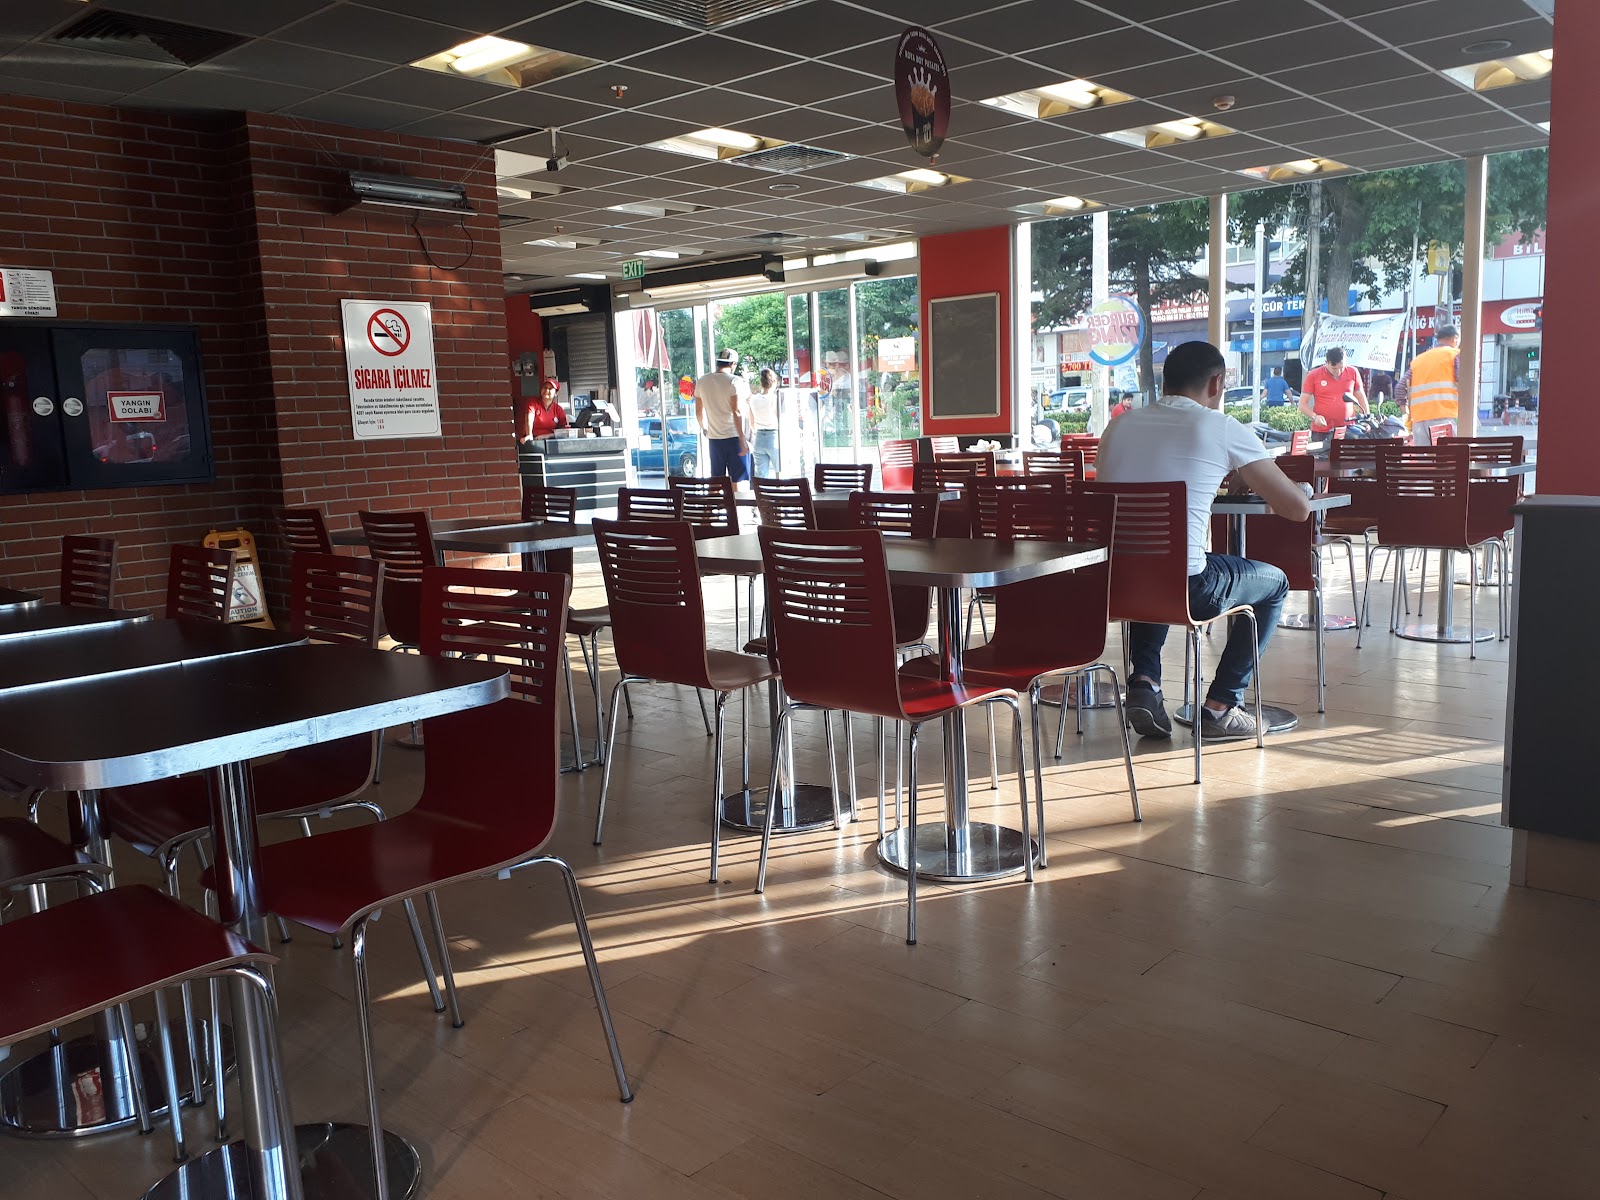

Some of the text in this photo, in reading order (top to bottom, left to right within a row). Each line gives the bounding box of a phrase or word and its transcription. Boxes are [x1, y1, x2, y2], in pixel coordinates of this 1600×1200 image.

[622, 260, 643, 279] EXIT
[1249, 300, 1284, 314] ÖGÜR
[354, 365, 431, 392] SİGARA İÇİLMEZ
[230, 607, 257, 615] AUTION
